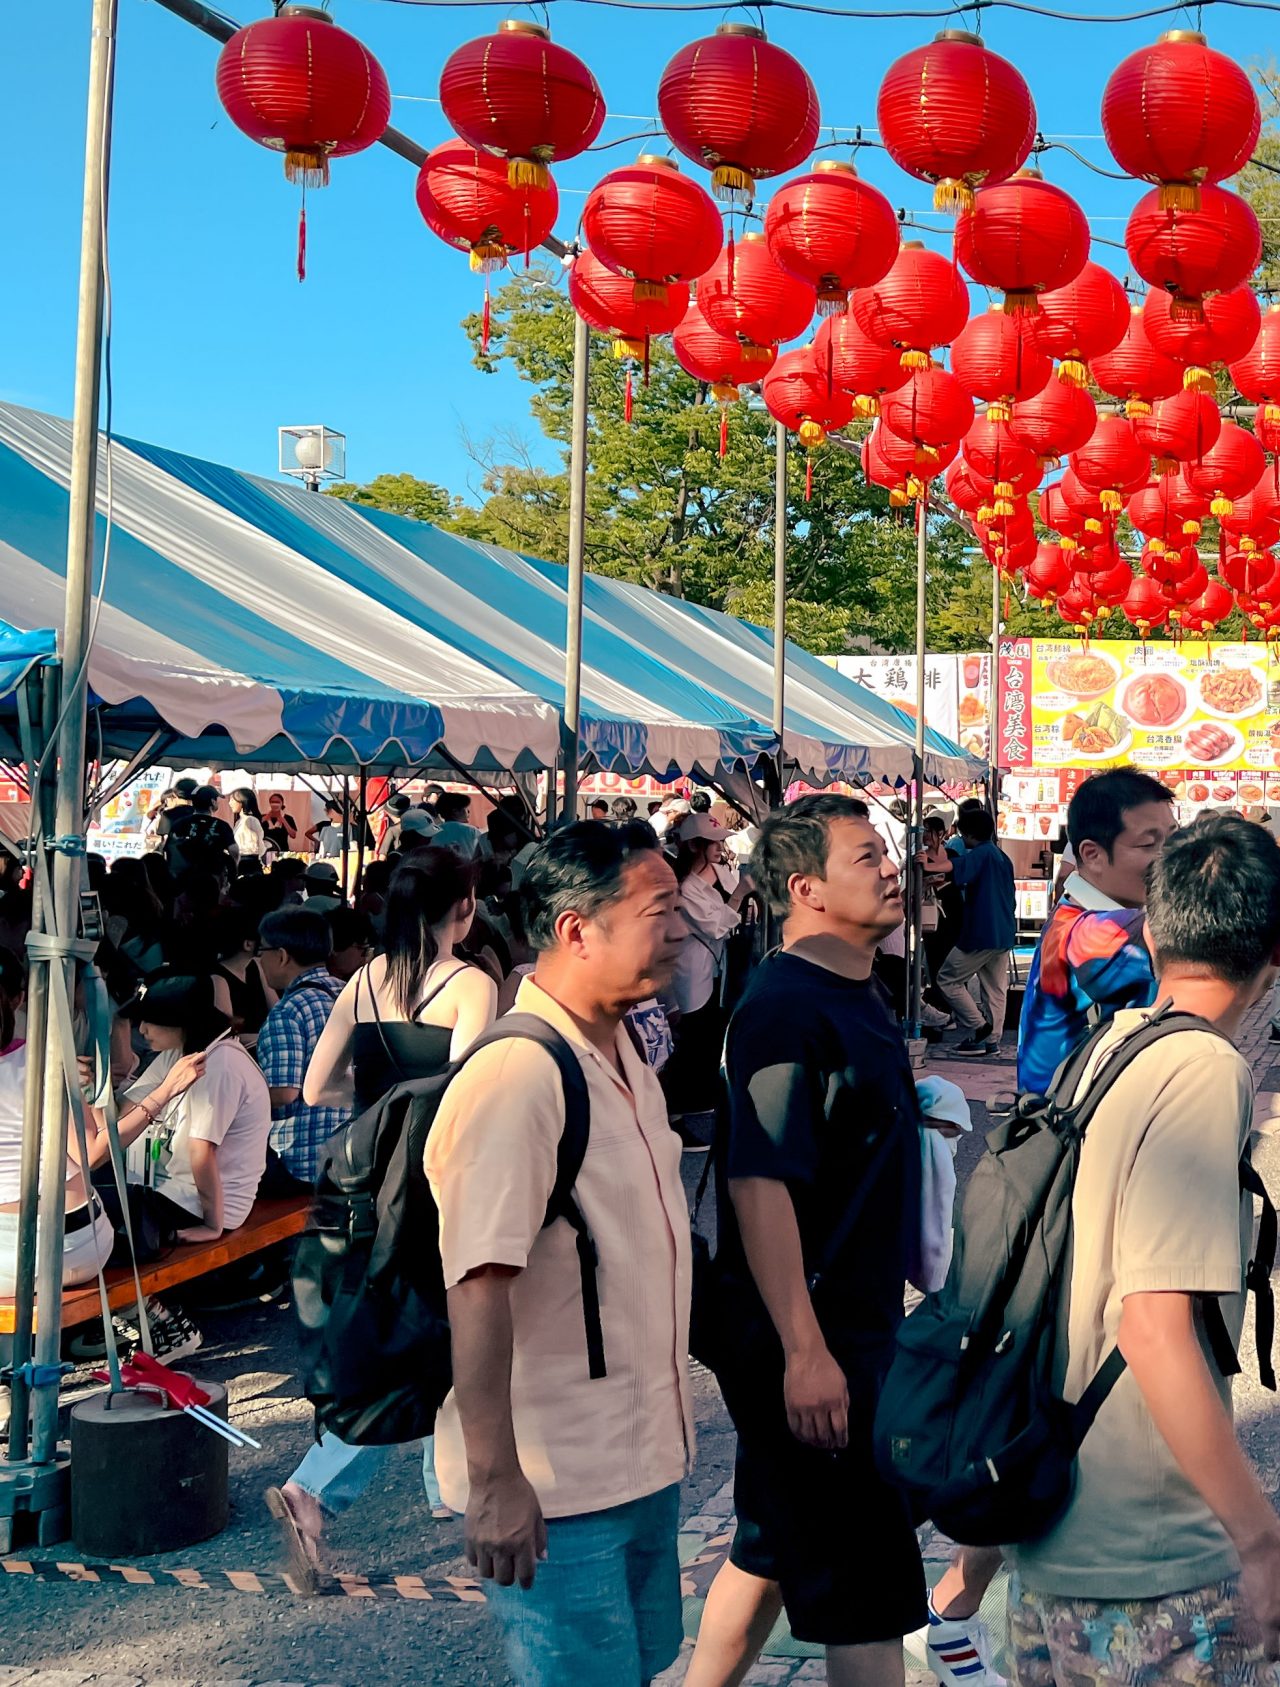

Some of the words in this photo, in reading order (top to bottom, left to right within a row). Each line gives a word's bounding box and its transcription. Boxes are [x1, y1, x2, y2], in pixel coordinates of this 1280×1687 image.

[869, 658, 918, 668] 台湾唐揚
[1003, 667, 1027, 762] 台湾美食
